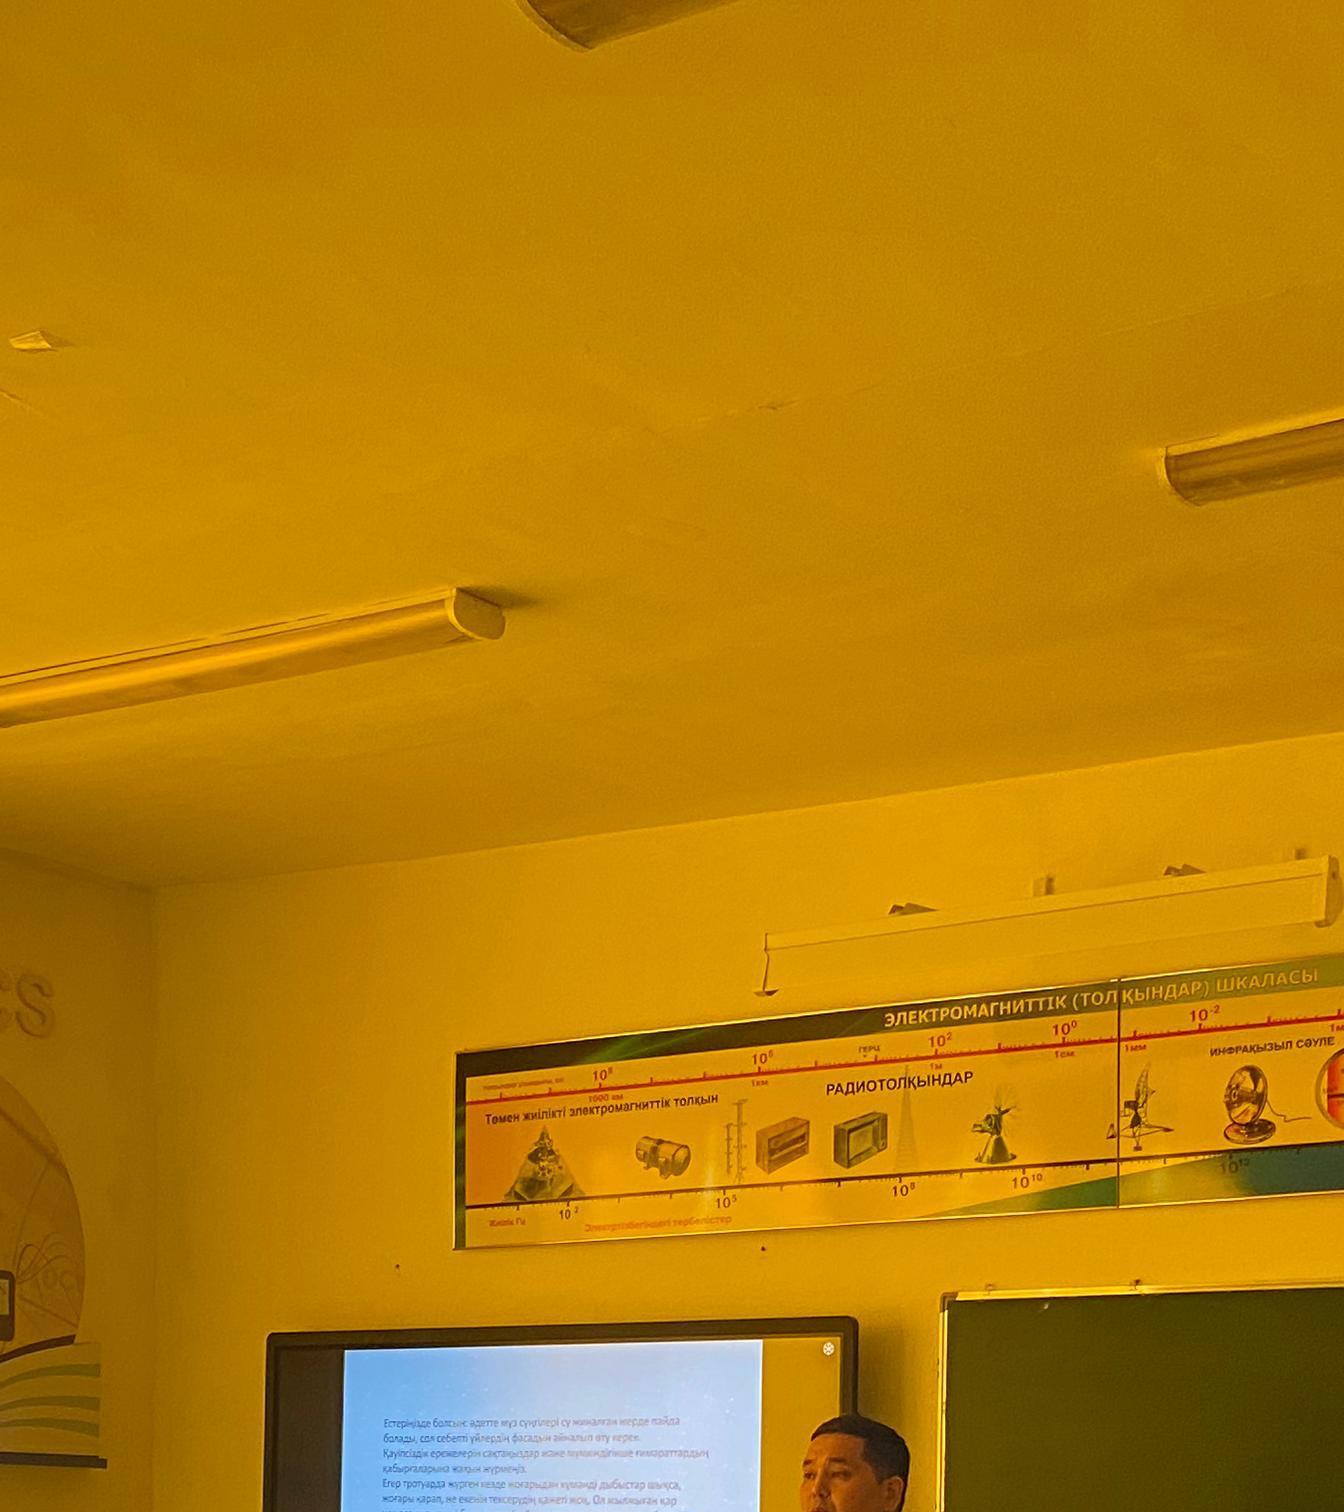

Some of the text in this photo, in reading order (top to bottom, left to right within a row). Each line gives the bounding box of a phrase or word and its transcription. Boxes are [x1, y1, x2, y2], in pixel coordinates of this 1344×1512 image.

[883, 993, 1068, 1028] ЭЛЕКТРОМАГНИТТІК
[1216, 966, 1320, 994] ШКАЛАСЫ
[1209, 1035, 1336, 1058] ИНФРАҚЫЗЫЛ СӘУЛЕ
[825, 1070, 974, 1097] РАДИОТОЛҚЫНДАР
[484, 1092, 719, 1126] Төмен жиілікті электромагниттік толқын
